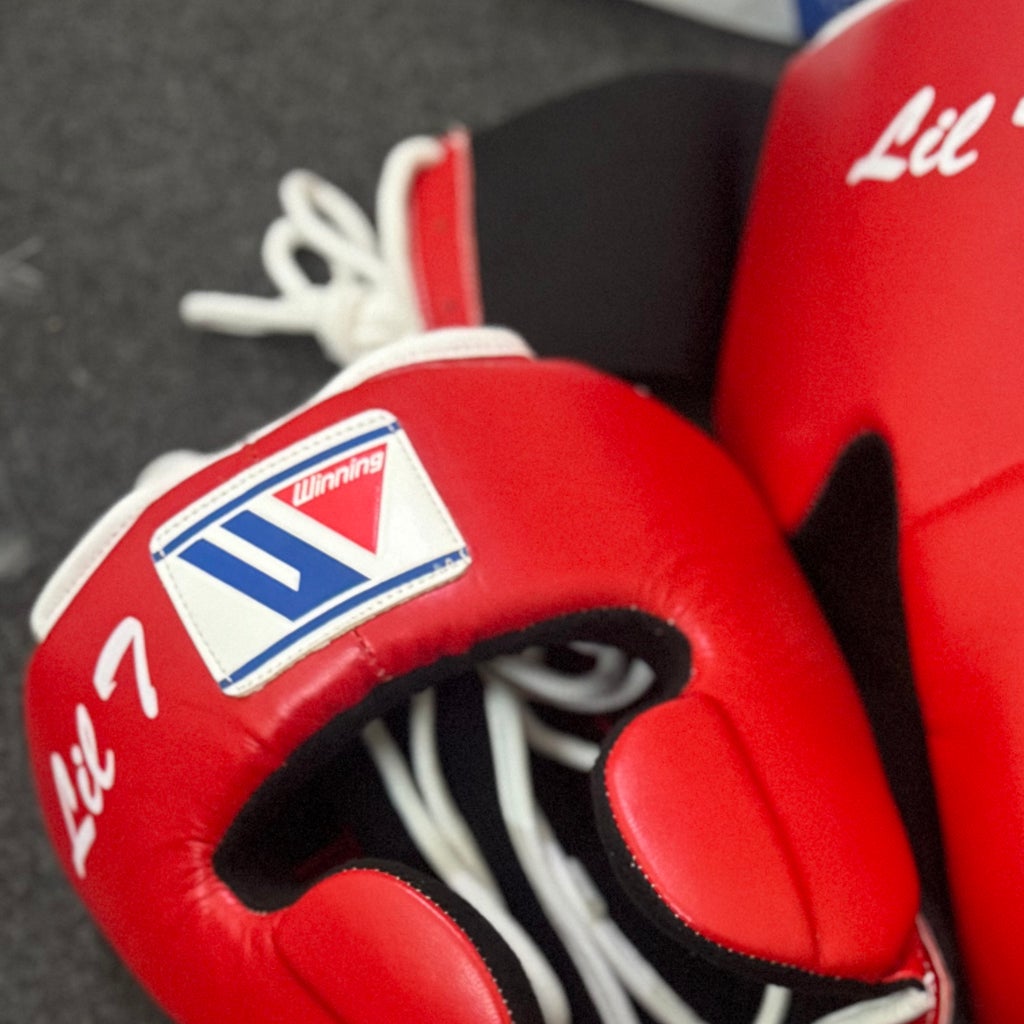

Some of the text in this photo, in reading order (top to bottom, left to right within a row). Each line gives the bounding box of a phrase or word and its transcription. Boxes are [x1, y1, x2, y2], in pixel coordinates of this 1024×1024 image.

[846, 86, 995, 185] Lil
[292, 449, 385, 507] Winning
[51, 703, 115, 879] Lil
